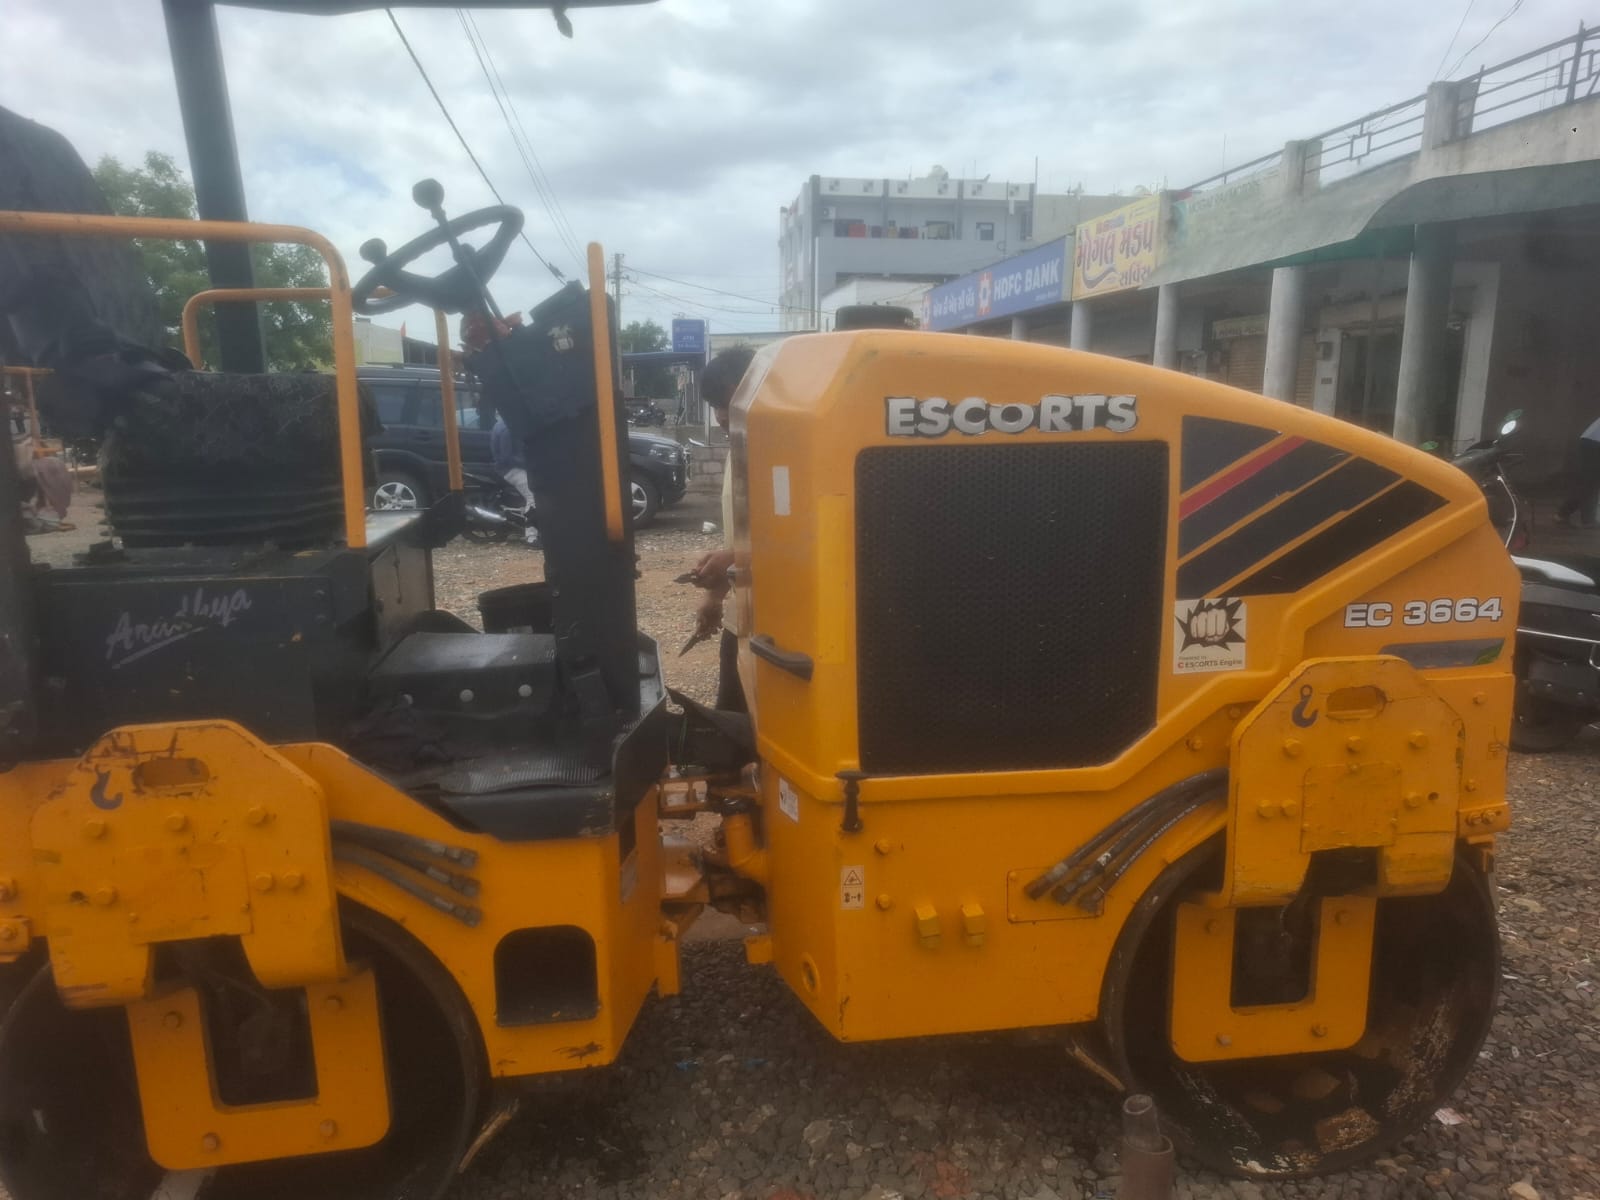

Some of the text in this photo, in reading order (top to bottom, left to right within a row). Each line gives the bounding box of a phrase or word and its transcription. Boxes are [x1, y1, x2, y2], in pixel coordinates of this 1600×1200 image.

[993, 259, 1060, 301] HDFC BANK
[886, 395, 1137, 436] ESCORTS
[1344, 597, 1503, 628] EC 3664
[1185, 660, 1218, 668] ESCORTS
